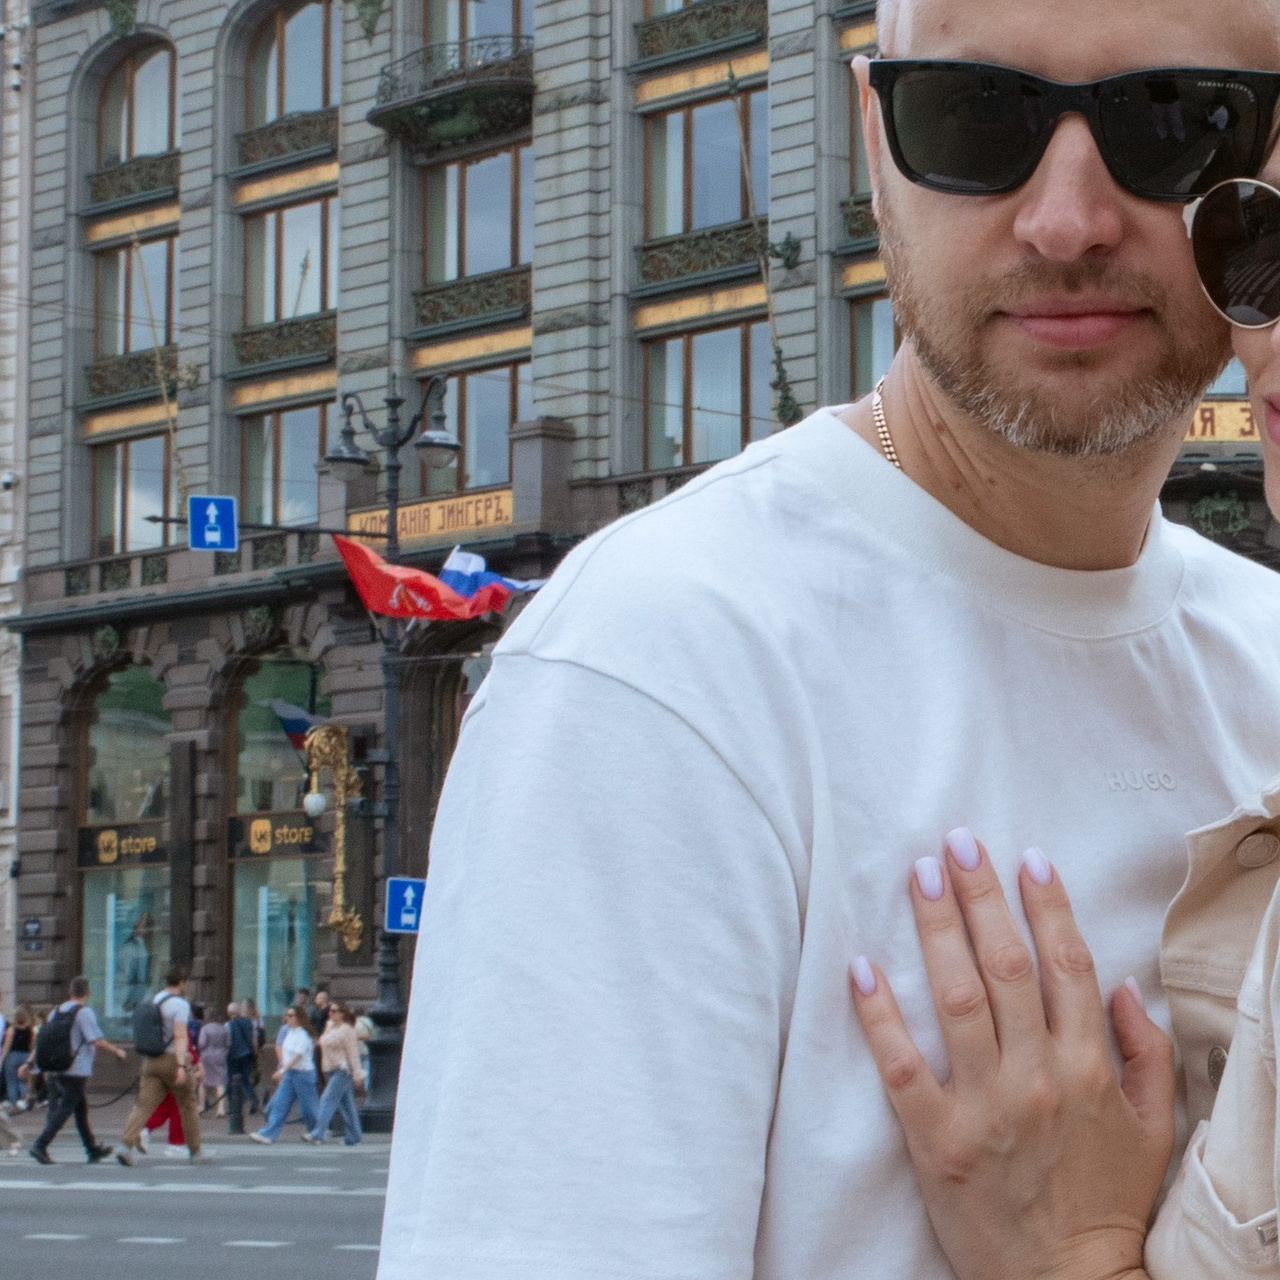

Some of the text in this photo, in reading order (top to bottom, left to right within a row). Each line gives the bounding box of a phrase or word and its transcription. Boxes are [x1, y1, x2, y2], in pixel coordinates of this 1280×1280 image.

[1103, 769, 1178, 792] HUGO
[120, 835, 157, 854] store
[274, 824, 314, 845] store
